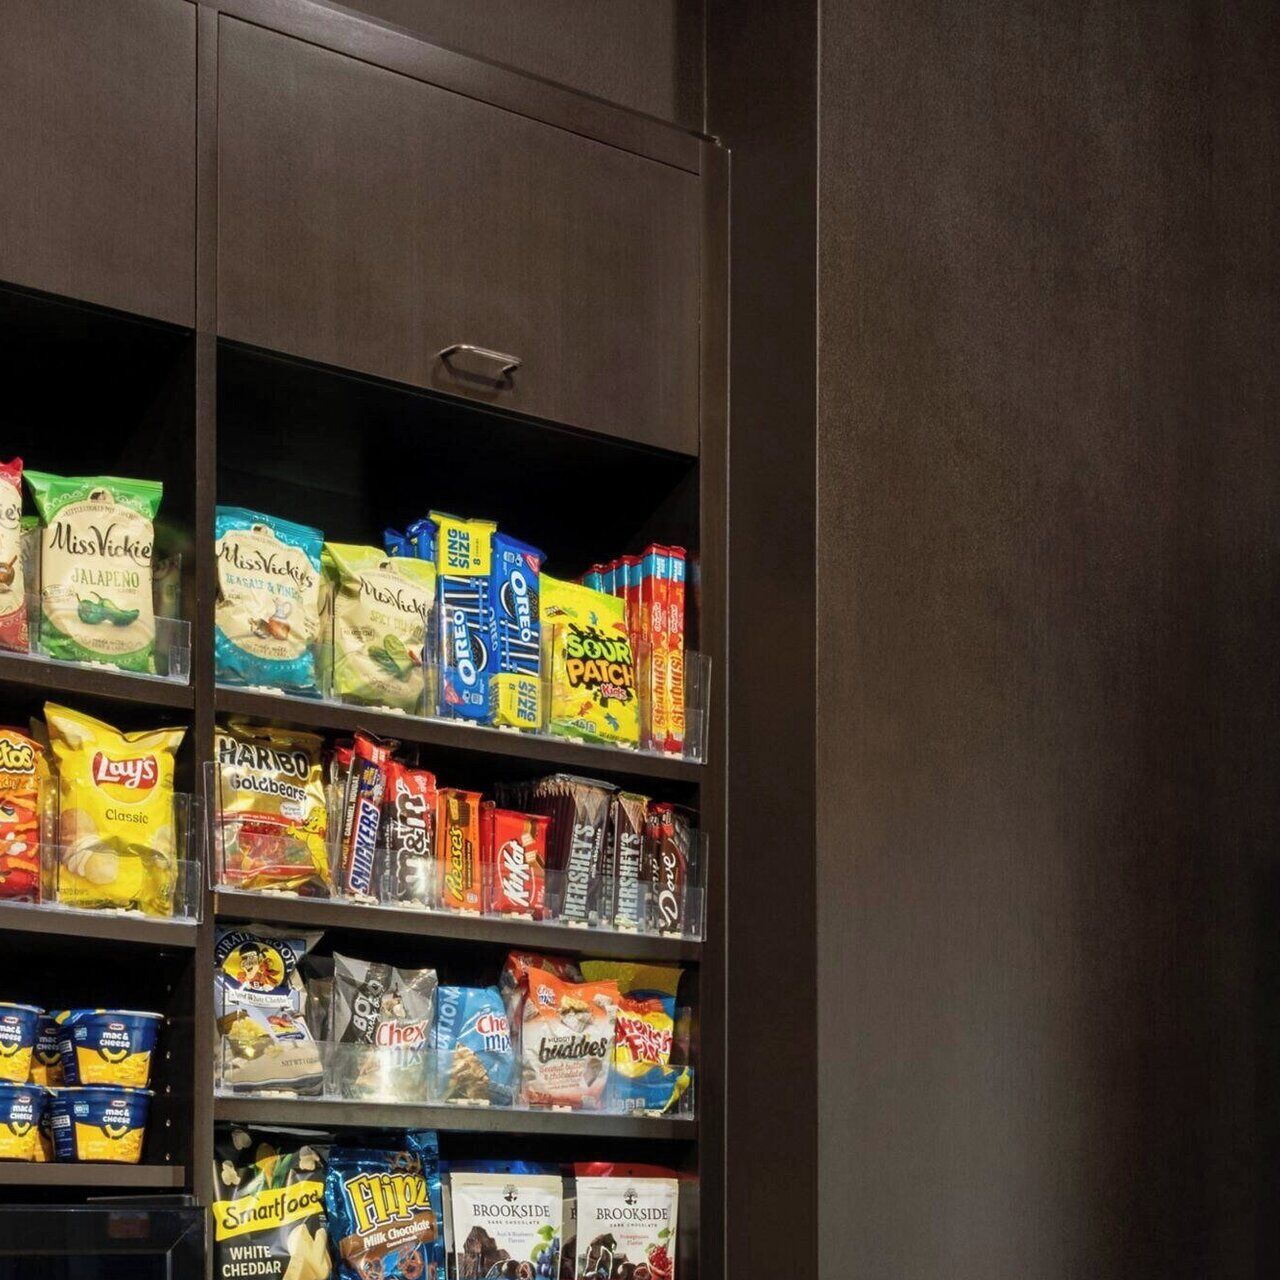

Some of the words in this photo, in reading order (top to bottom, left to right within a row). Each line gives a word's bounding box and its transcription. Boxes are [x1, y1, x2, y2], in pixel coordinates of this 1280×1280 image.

[448, 528, 459, 567] KING
[458, 530, 470, 569] SIZE
[510, 570, 532, 643] OREO
[454, 610, 476, 685] OREO
[567, 634, 633, 664] SOUR
[566, 657, 635, 687] PATCH
[95, 751, 158, 789] Lay's
[218, 738, 310, 780] HARIBO
[231, 774, 308, 801] Goldbears
[105, 808, 150, 825] Classic
[351, 801, 380, 895] SNICKERS
[445, 825, 463, 901] Reese's
[563, 824, 595, 919] HERSHEY'S
[618, 832, 640, 925] HERSHEY'S
[659, 838, 677, 926] Dove
[376, 1020, 428, 1046] Chex
[539, 1036, 608, 1063] buddies
[222, 1189, 320, 1230] Smartfood
[346, 1174, 432, 1232] Flipz
[472, 1203, 551, 1218] BROOKSIDE
[596, 1207, 669, 1221] BROOKSIDE
[229, 1245, 271, 1260] WHITE
[363, 1231, 387, 1250] Milk
[386, 1219, 431, 1240] Chocolate
[222, 1261, 282, 1278] CHEDDAR
